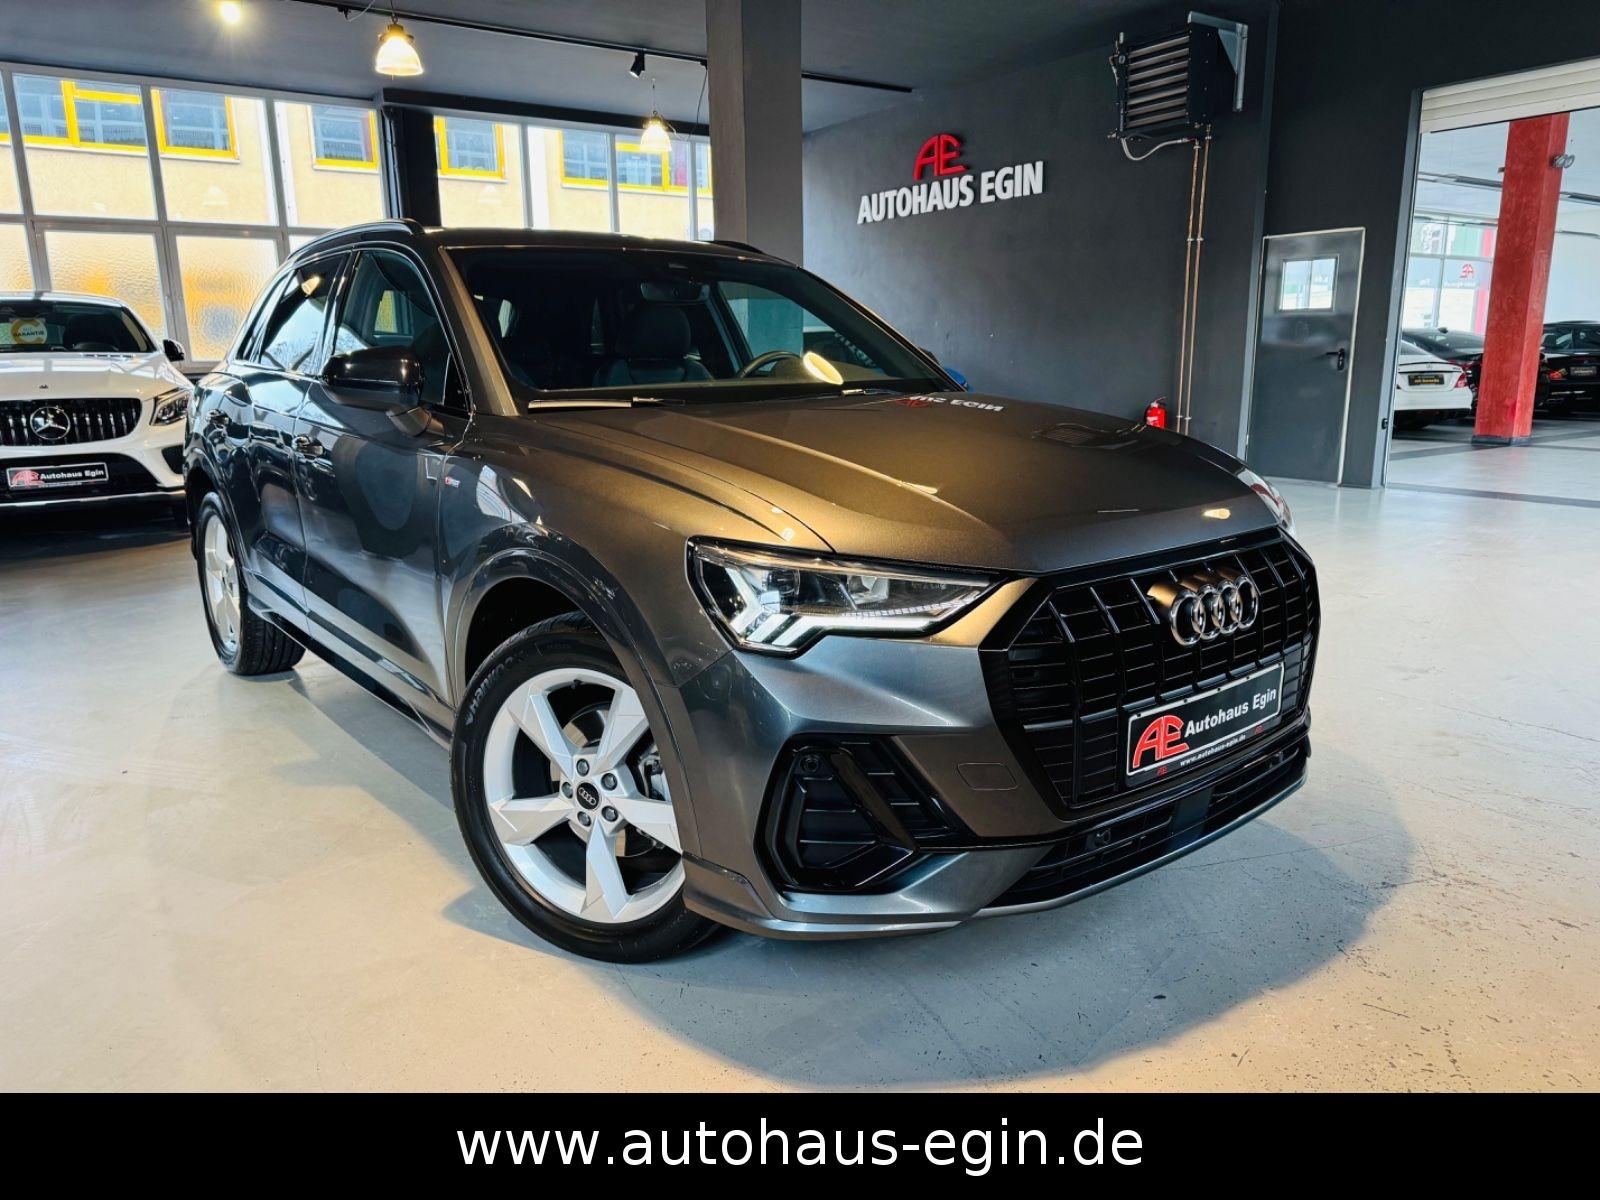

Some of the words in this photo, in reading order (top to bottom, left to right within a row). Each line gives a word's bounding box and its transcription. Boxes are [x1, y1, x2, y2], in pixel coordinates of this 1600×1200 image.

[857, 174, 974, 225] AUTOHAUS
[979, 161, 1044, 203] EGIN
[40, 471, 83, 480] Autohaus
[84, 469, 104, 478] Egin
[1185, 702, 1248, 736] Autohaus
[1253, 688, 1276, 709] Egin
[1180, 735, 1246, 766] www.autohaus-egin.de
